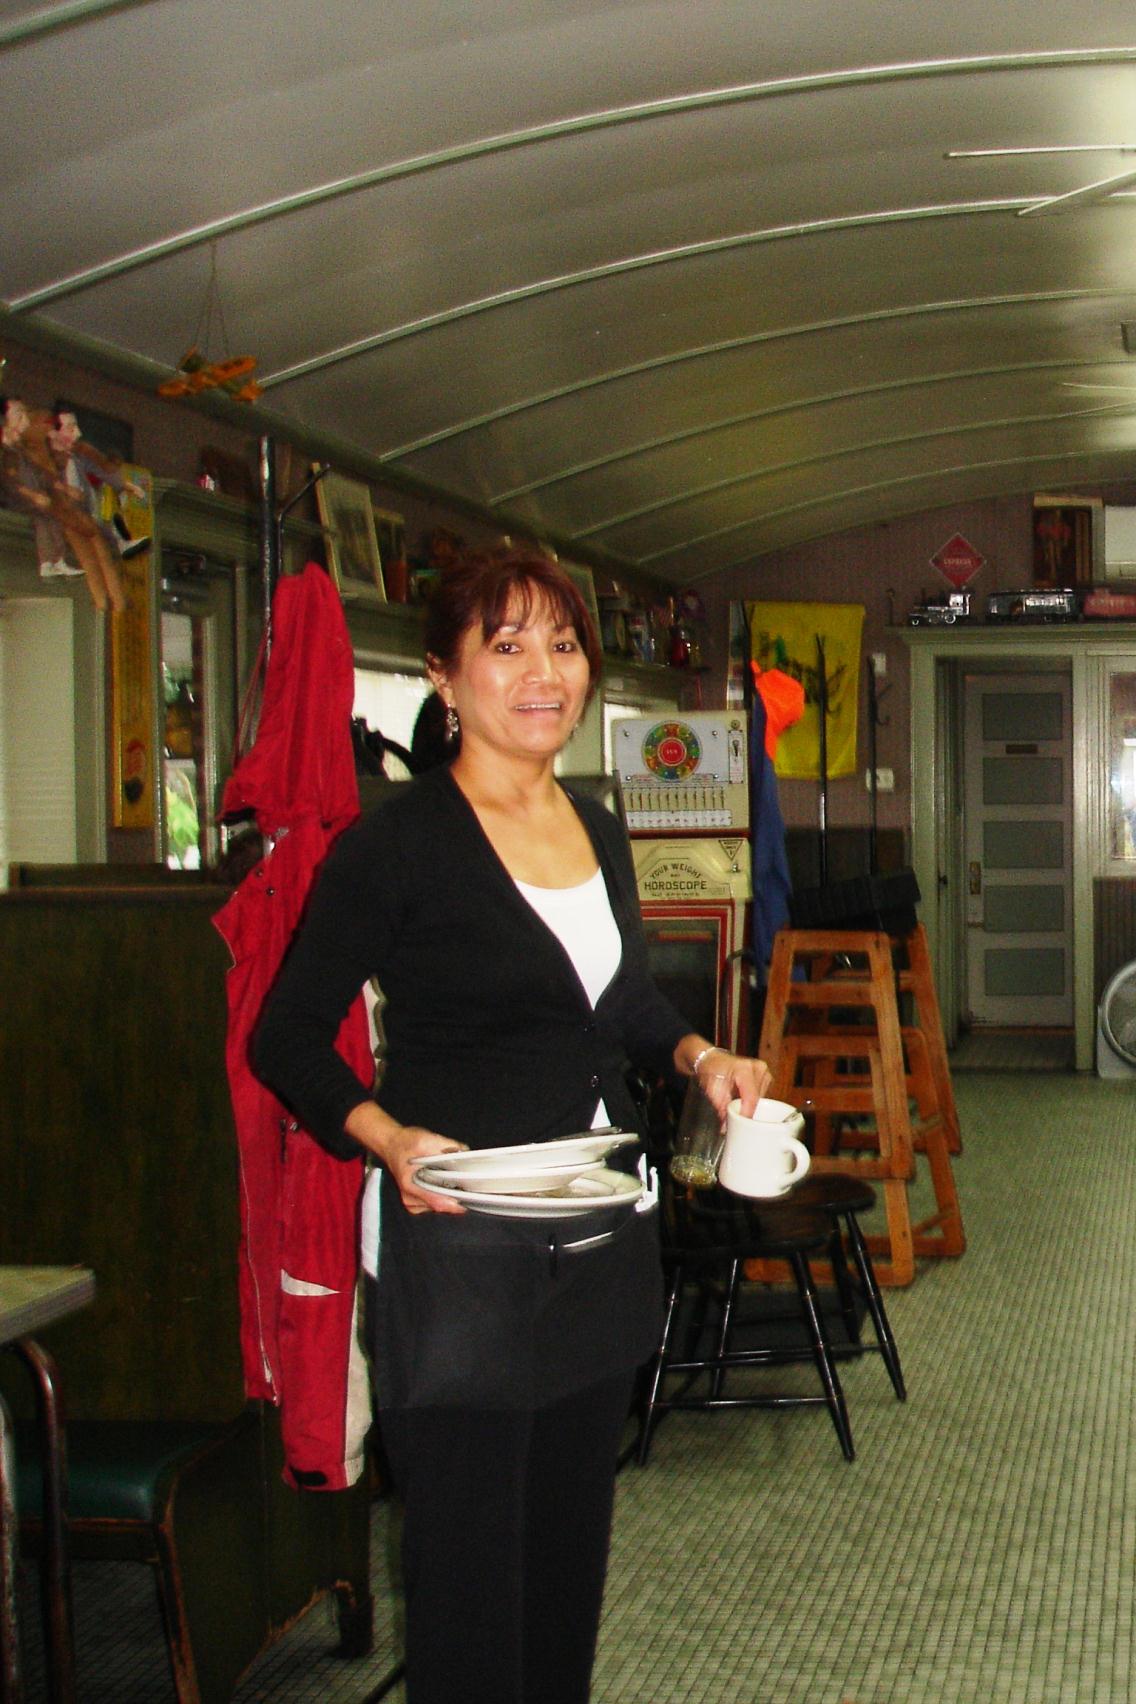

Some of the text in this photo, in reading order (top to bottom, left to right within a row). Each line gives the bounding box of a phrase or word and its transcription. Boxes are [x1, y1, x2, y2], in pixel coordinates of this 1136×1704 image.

[650, 863, 702, 879] YOUR WEIGHT
[644, 881, 707, 890] HOROSCOPE
